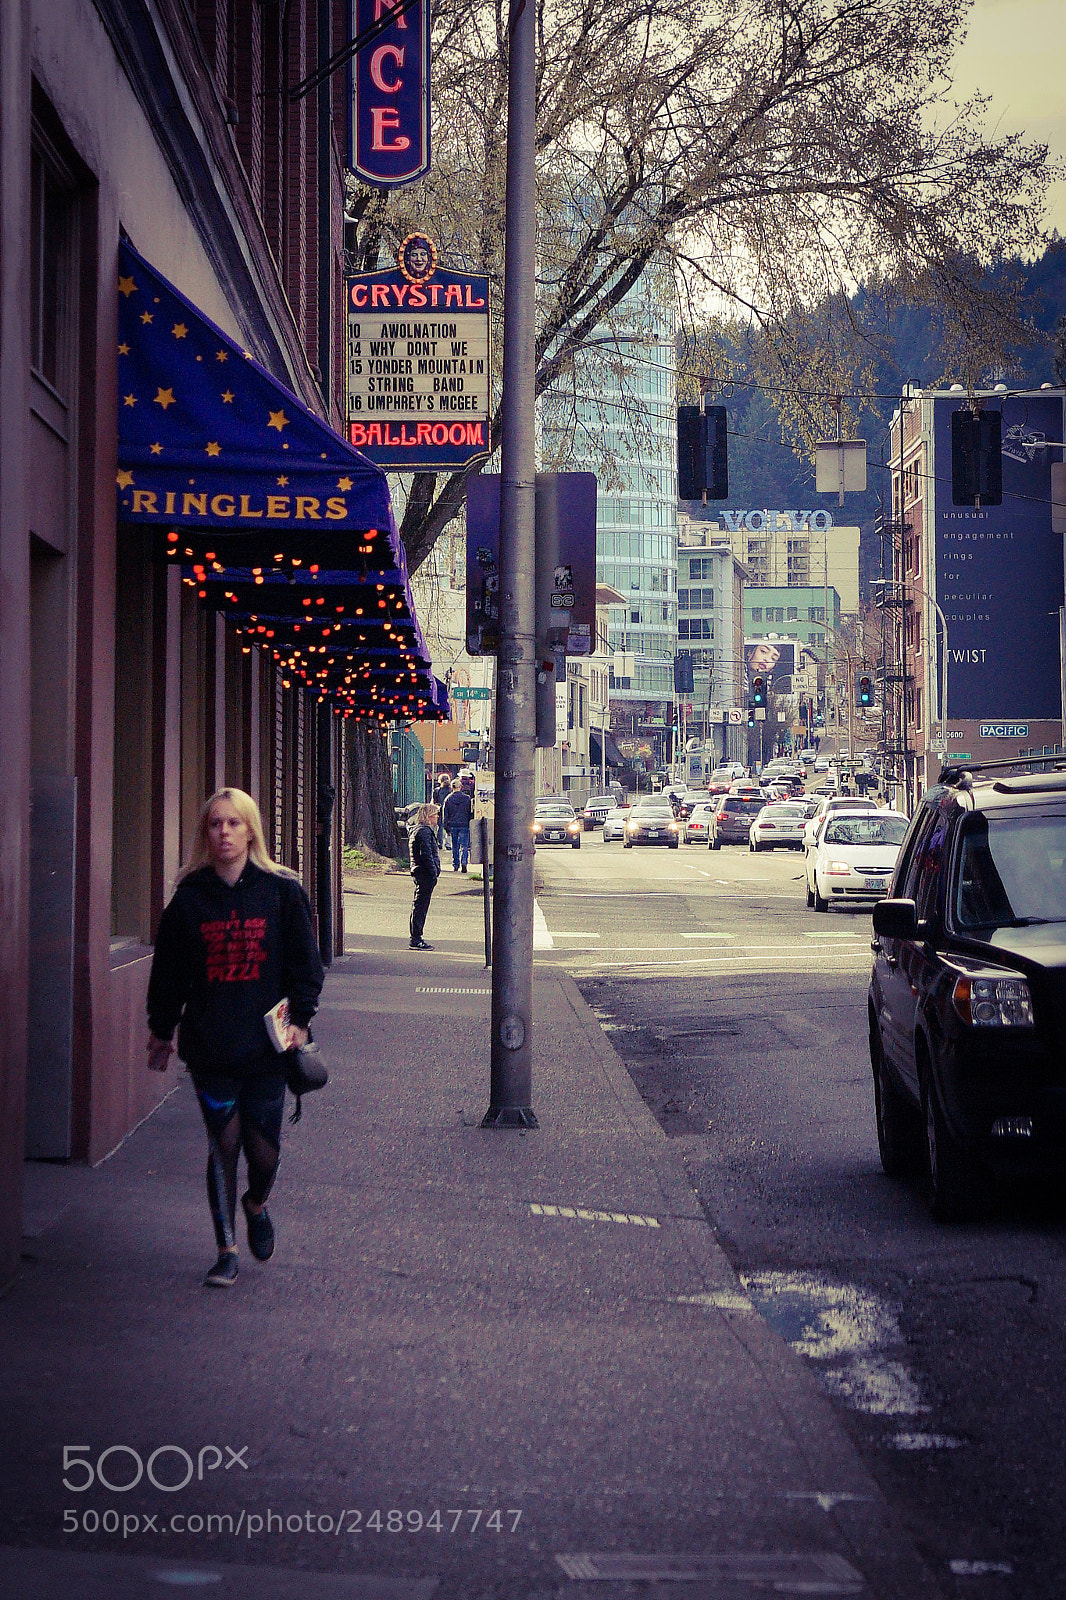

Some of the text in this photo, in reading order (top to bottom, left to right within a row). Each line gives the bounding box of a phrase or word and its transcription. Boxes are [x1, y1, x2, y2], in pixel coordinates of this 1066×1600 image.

[351, 284, 485, 307] CRYSTAL
[349, 323, 457, 339] 10 AWOLNATION
[350, 341, 468, 357] 14 WHY DONT WE
[350, 359, 484, 375] 15 YONDER MOUNTAIN
[367, 377, 464, 393] STRING BAND
[350, 395, 478, 411] 16 UMPHREY'S MCGEE
[351, 423, 485, 446] BALLROOM
[131, 490, 349, 520] RINGLERS
[719, 509, 833, 532] VOLVO
[943, 511, 989, 519] unusual
[943, 532, 1014, 541] engagement
[943, 552, 974, 560] rings
[943, 572, 960, 580] for
[944, 593, 994, 601] peculiar
[944, 613, 990, 621] couples
[946, 649, 987, 663] TWIST
[981, 726, 1027, 736] PACIFIC
